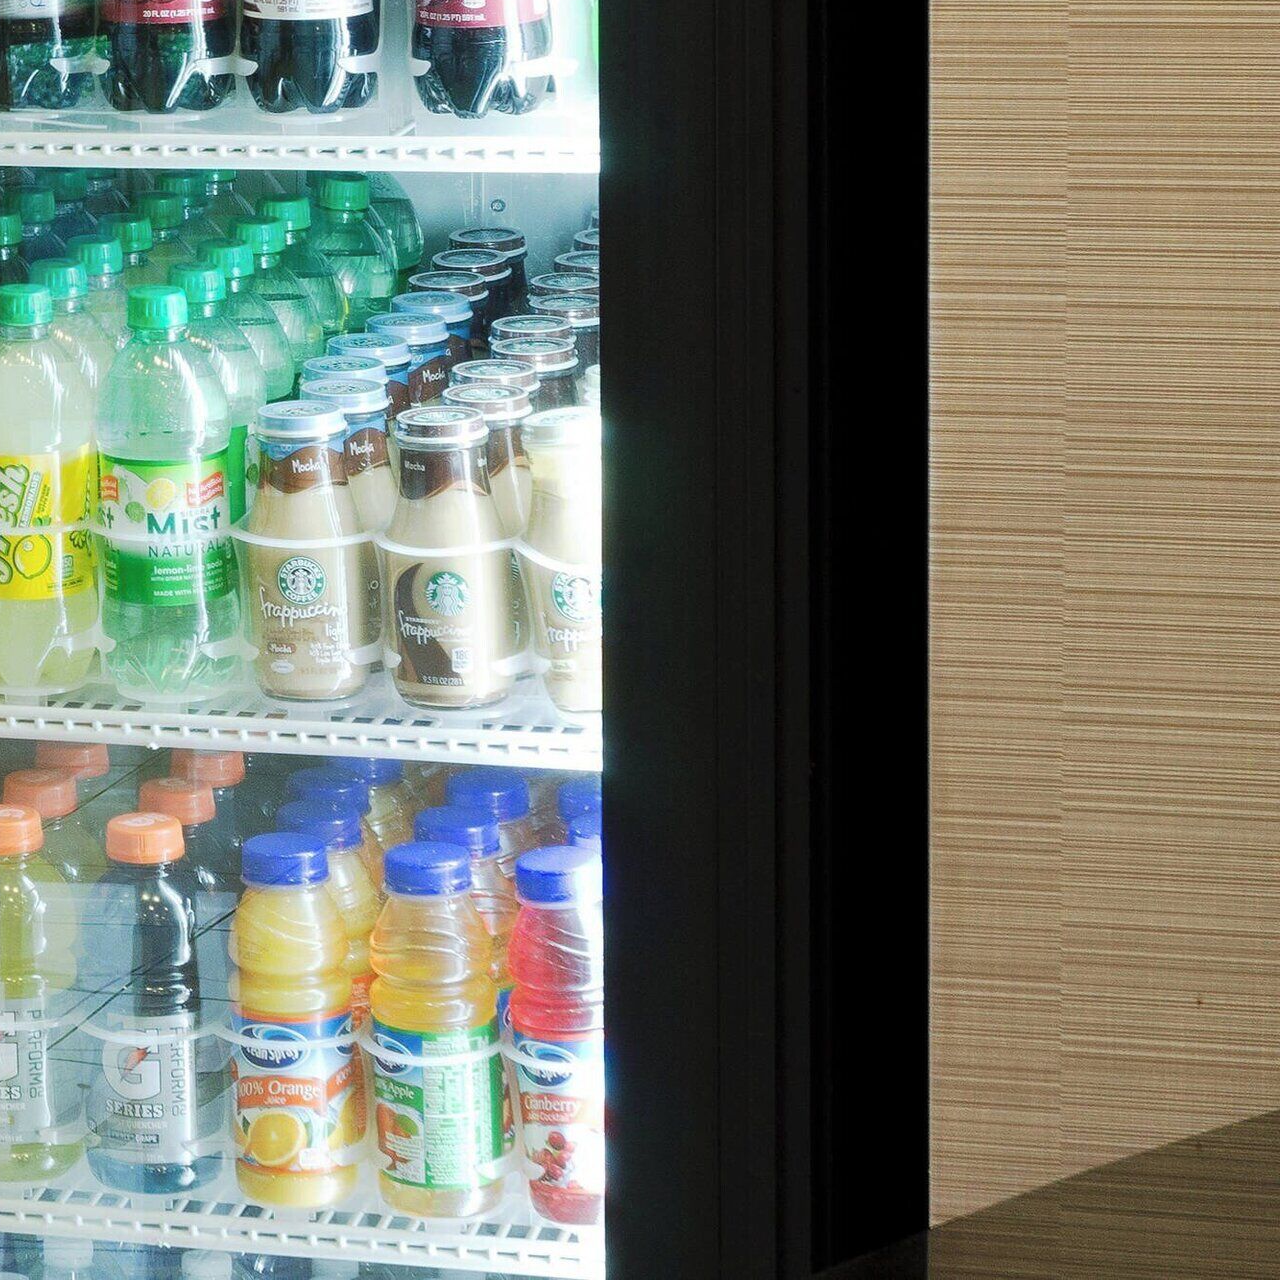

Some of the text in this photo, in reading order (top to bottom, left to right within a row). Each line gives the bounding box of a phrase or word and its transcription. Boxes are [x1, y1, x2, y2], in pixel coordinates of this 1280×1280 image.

[292, 460, 323, 474] Mocha
[404, 461, 425, 472] Mocha
[280, 558, 324, 580] STARBUCKS
[285, 589, 320, 605] COFFEE
[268, 1080, 321, 1100] Orange
[387, 1084, 415, 1100] Apple
[264, 1096, 286, 1105] Juice
[524, 1096, 580, 1114] Cranberry
[106, 1100, 163, 1118] SERIES
